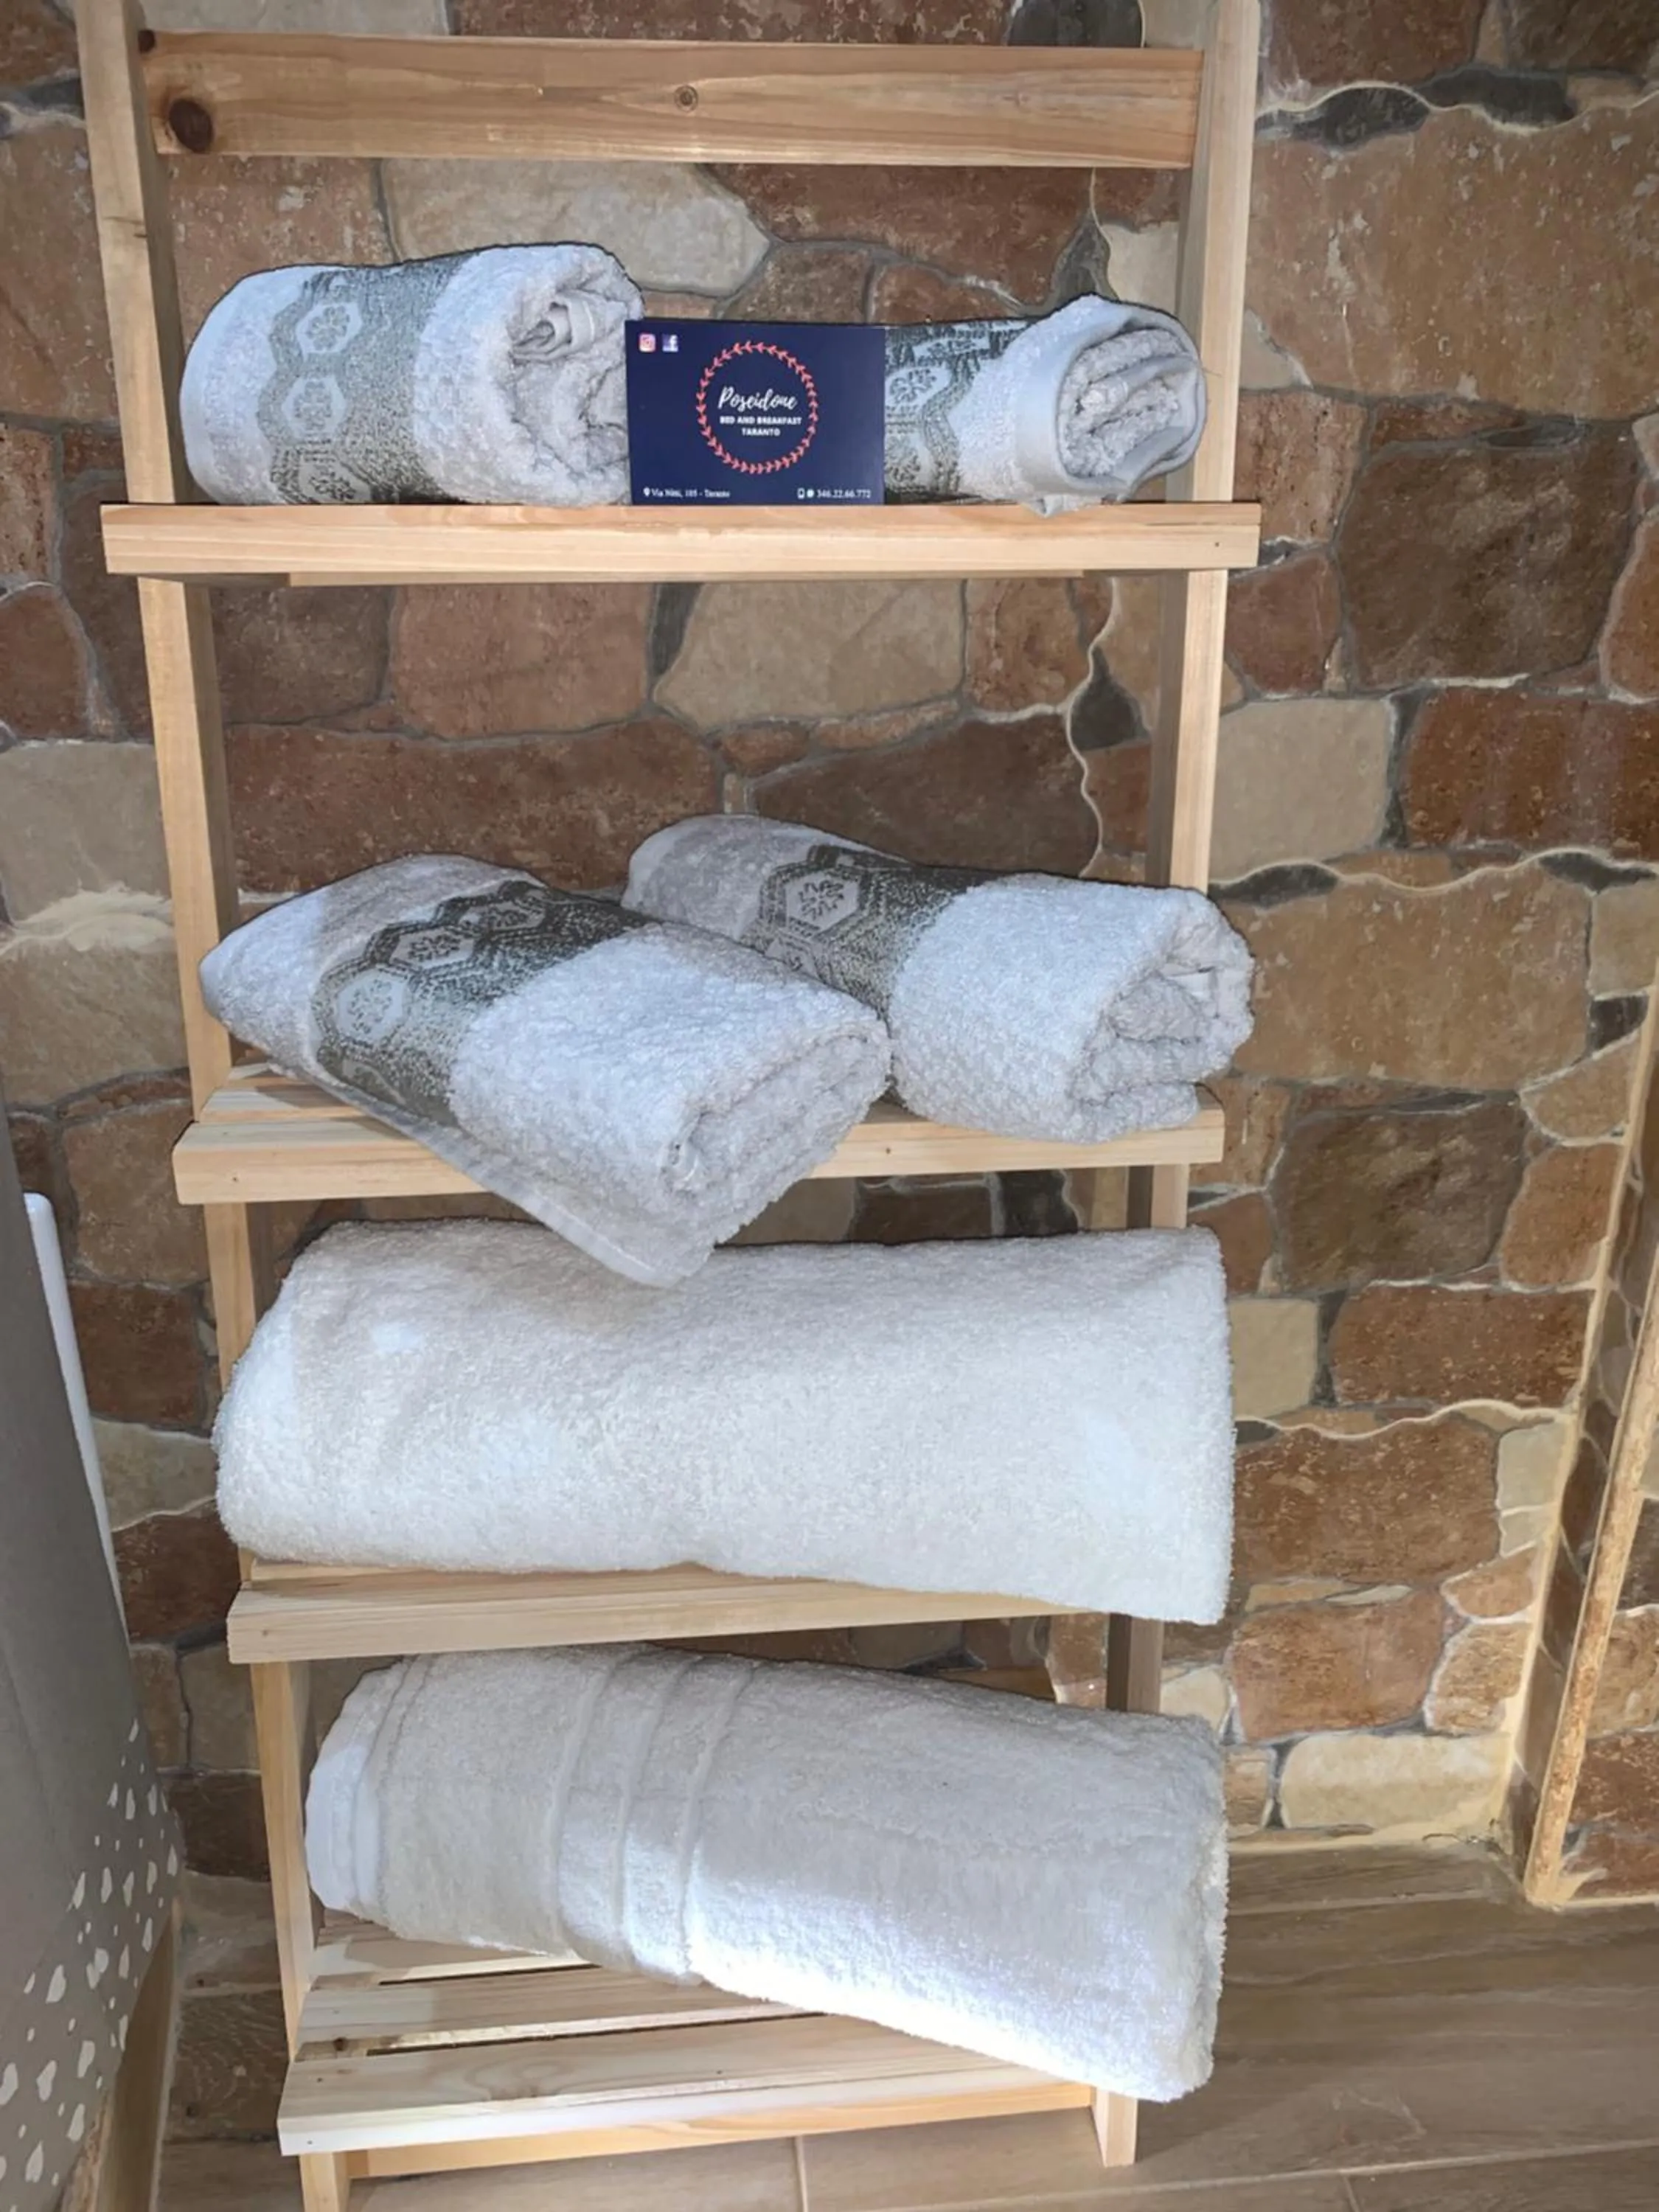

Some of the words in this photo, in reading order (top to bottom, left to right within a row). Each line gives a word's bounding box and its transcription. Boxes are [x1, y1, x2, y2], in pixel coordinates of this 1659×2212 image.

[717, 386, 797, 412] Poseidone
[720, 416, 735, 425] BED
[737, 416, 756, 425] AND
[757, 416, 802, 425] BREAKFAST
[742, 428, 781, 437] TARANTO
